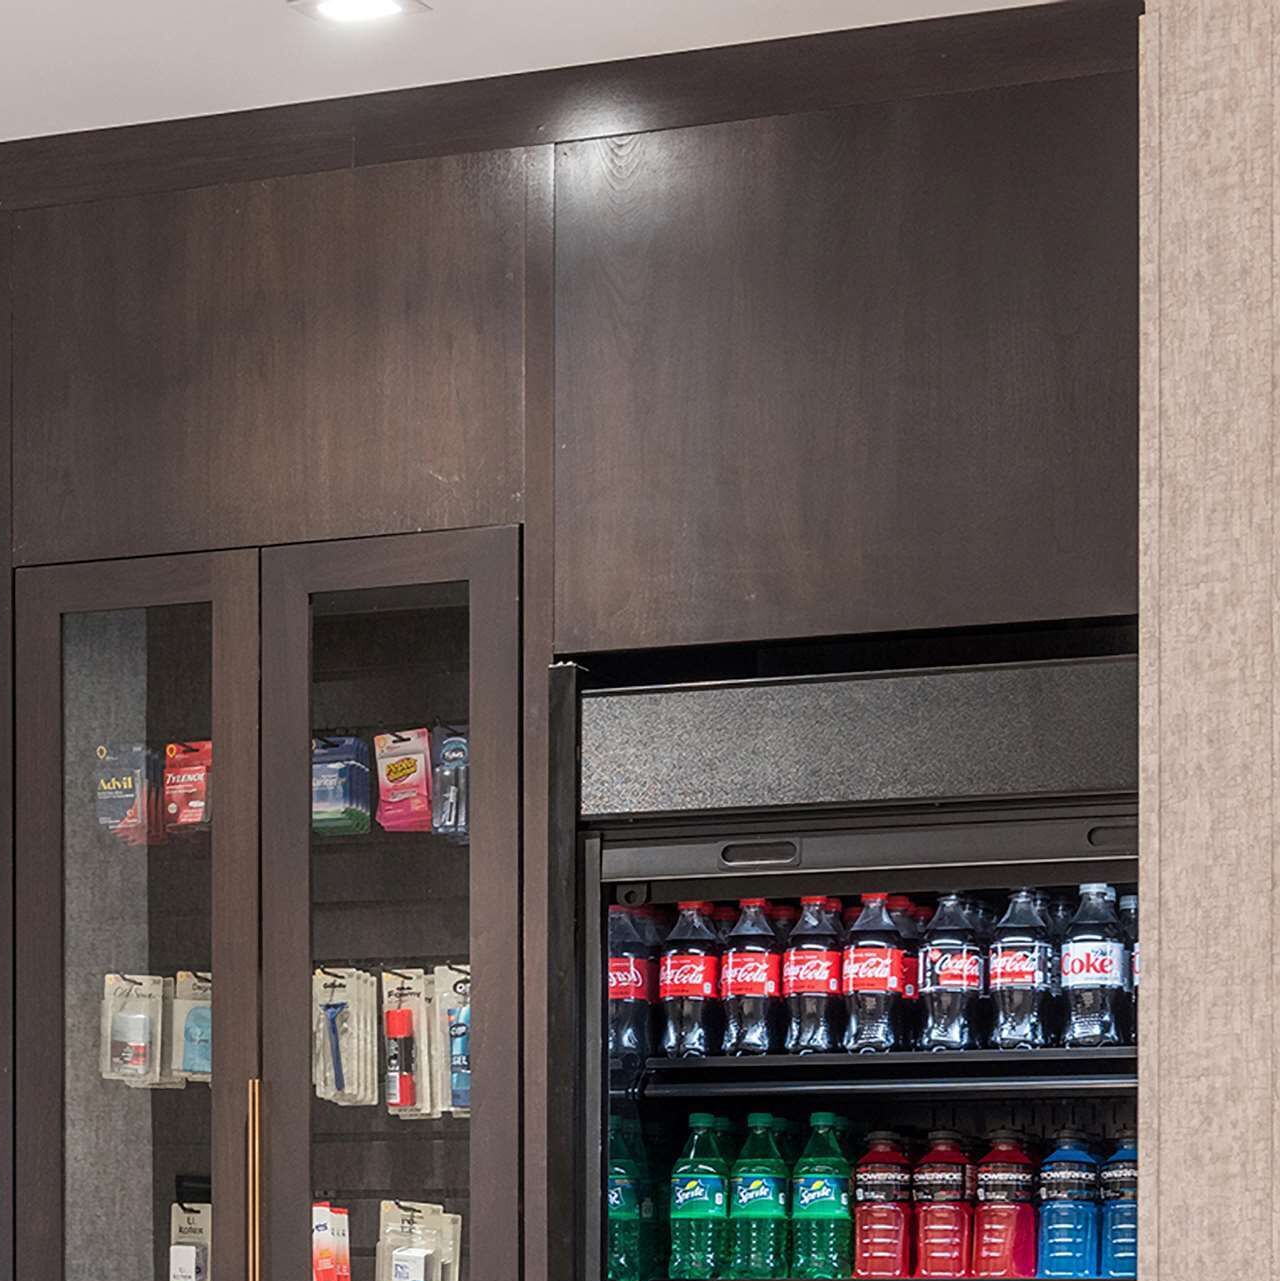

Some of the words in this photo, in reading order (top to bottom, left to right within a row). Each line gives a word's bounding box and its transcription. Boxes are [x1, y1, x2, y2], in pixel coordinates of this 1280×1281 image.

[100, 776, 132, 790] Advil
[1061, 952, 1113, 977] Coke
[675, 1185, 706, 1202] Sprite
[738, 1185, 770, 1202] Sprite
[799, 1185, 831, 1203] Sprite
